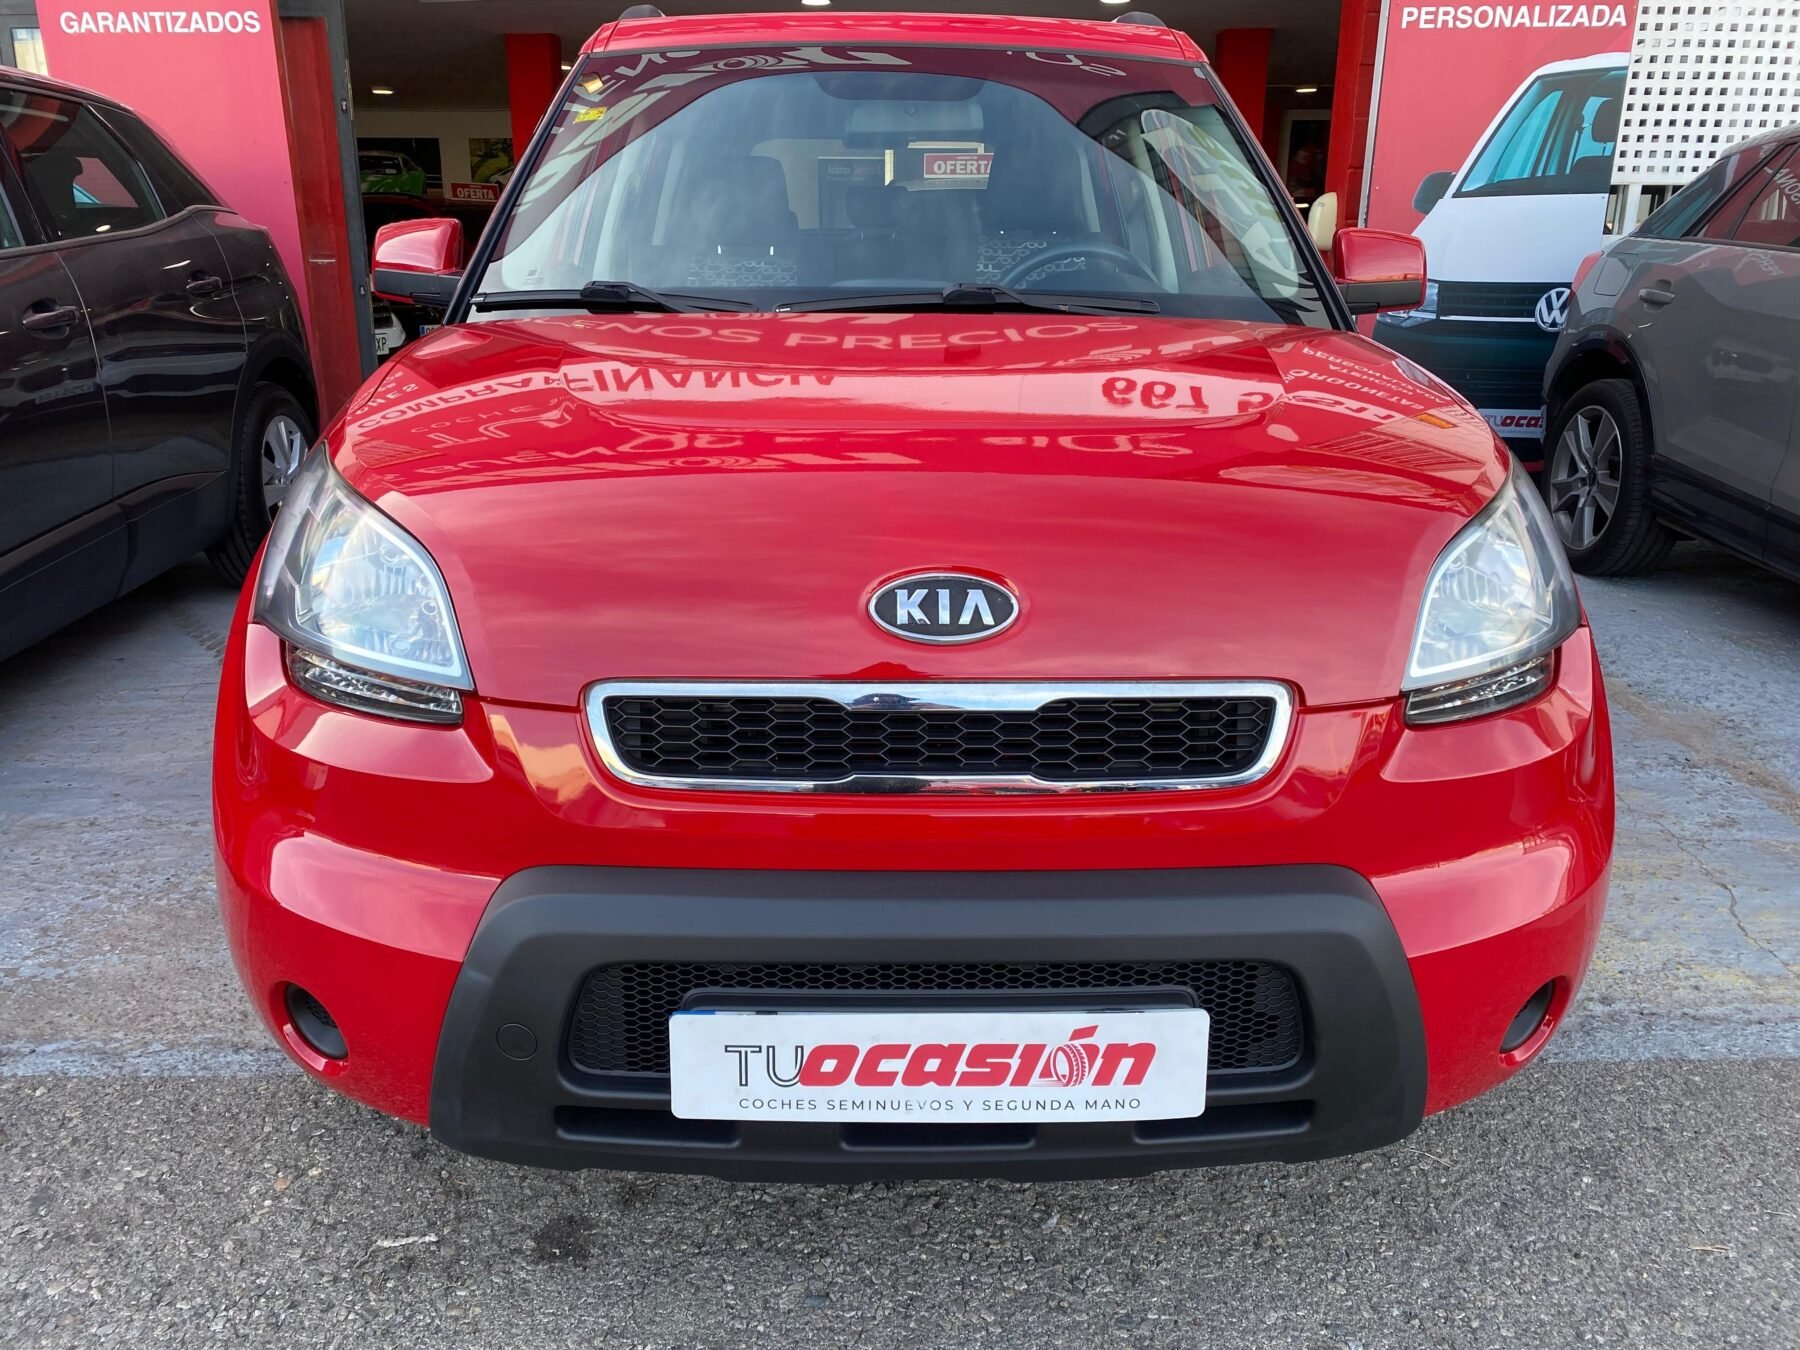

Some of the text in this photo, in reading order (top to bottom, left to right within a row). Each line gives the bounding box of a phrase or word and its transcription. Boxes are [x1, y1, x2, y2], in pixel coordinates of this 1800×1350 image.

[59, 10, 261, 35] GARANTIZADOS
[1401, 4, 1627, 29] PERSONALIZADA
[456, 187, 495, 200] OFERTA
[895, 588, 996, 626] KIA
[739, 1098, 1141, 1111] COCHES SEMINUEVOS Y SEGUNDA MANO
